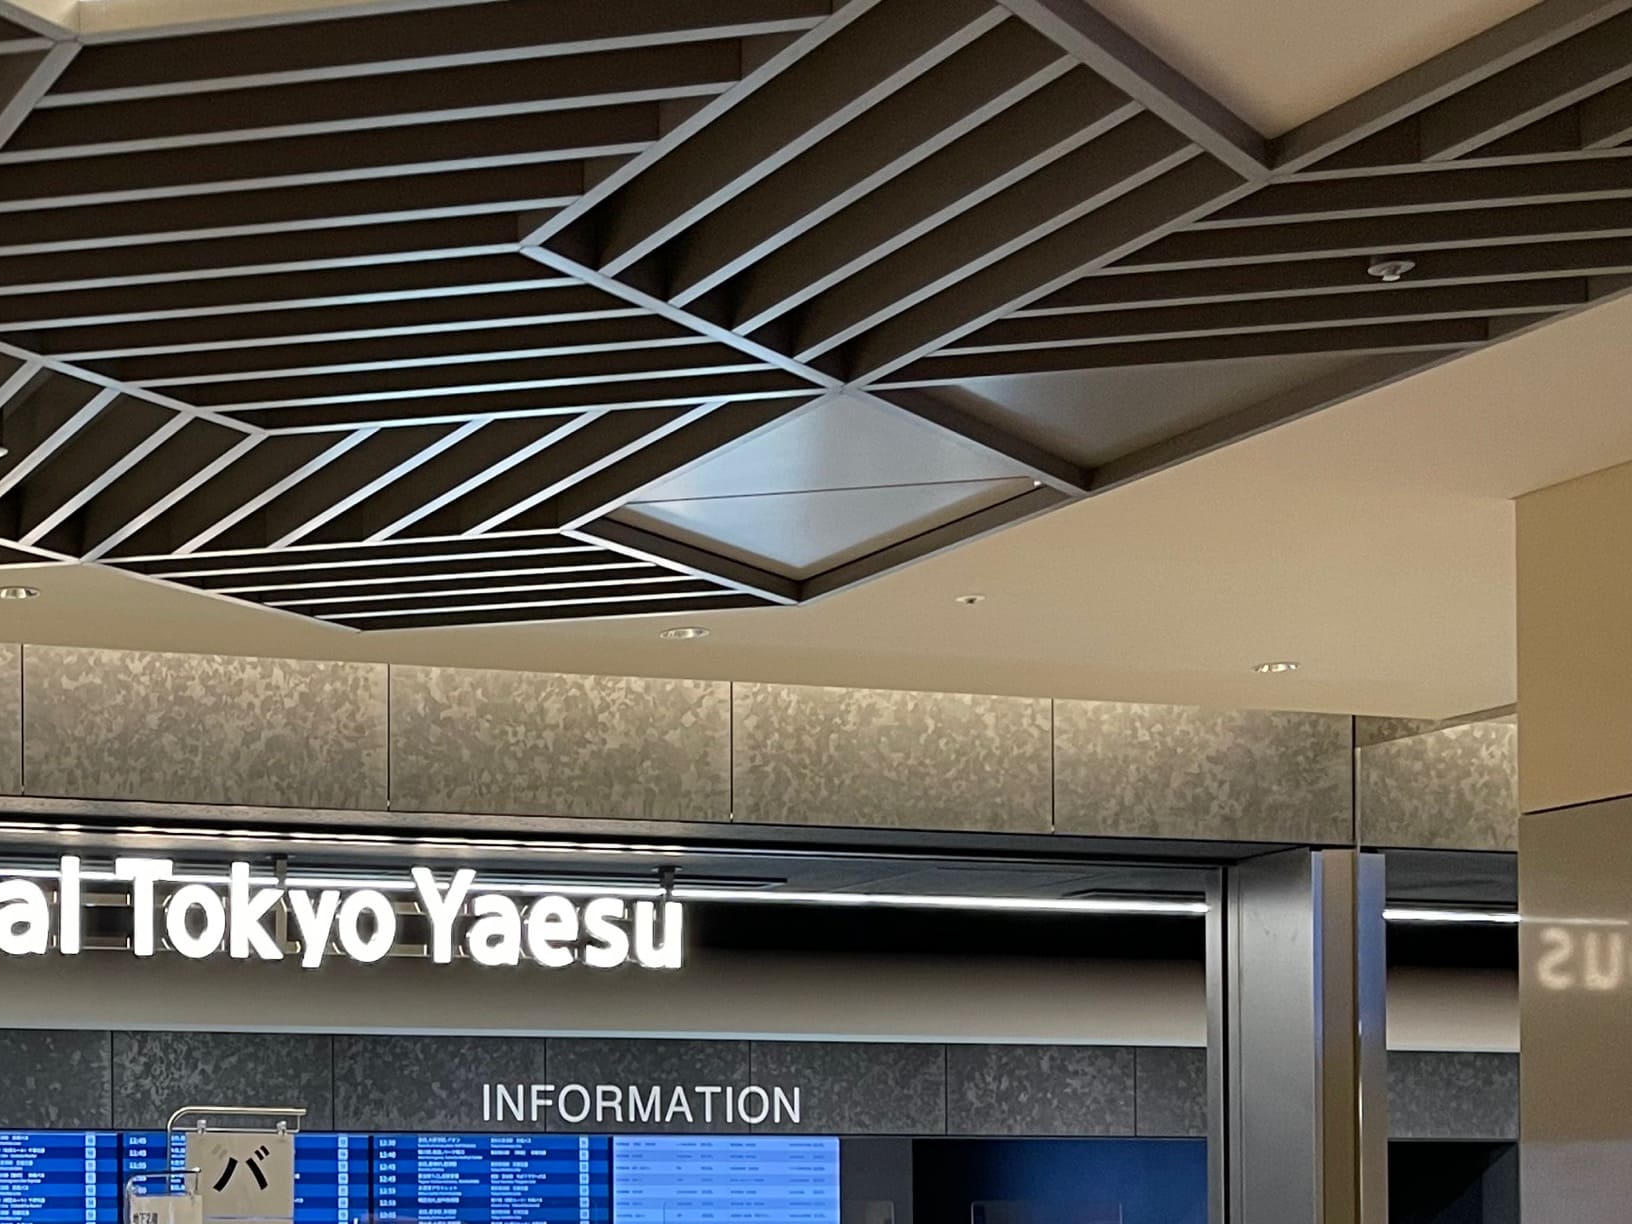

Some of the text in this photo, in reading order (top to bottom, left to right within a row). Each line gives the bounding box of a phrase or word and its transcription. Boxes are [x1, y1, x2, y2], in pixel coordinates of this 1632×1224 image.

[116, 858, 397, 969] Tokyo
[412, 867, 683, 970] Yaesu
[483, 1084, 800, 1124] INFORMATION
